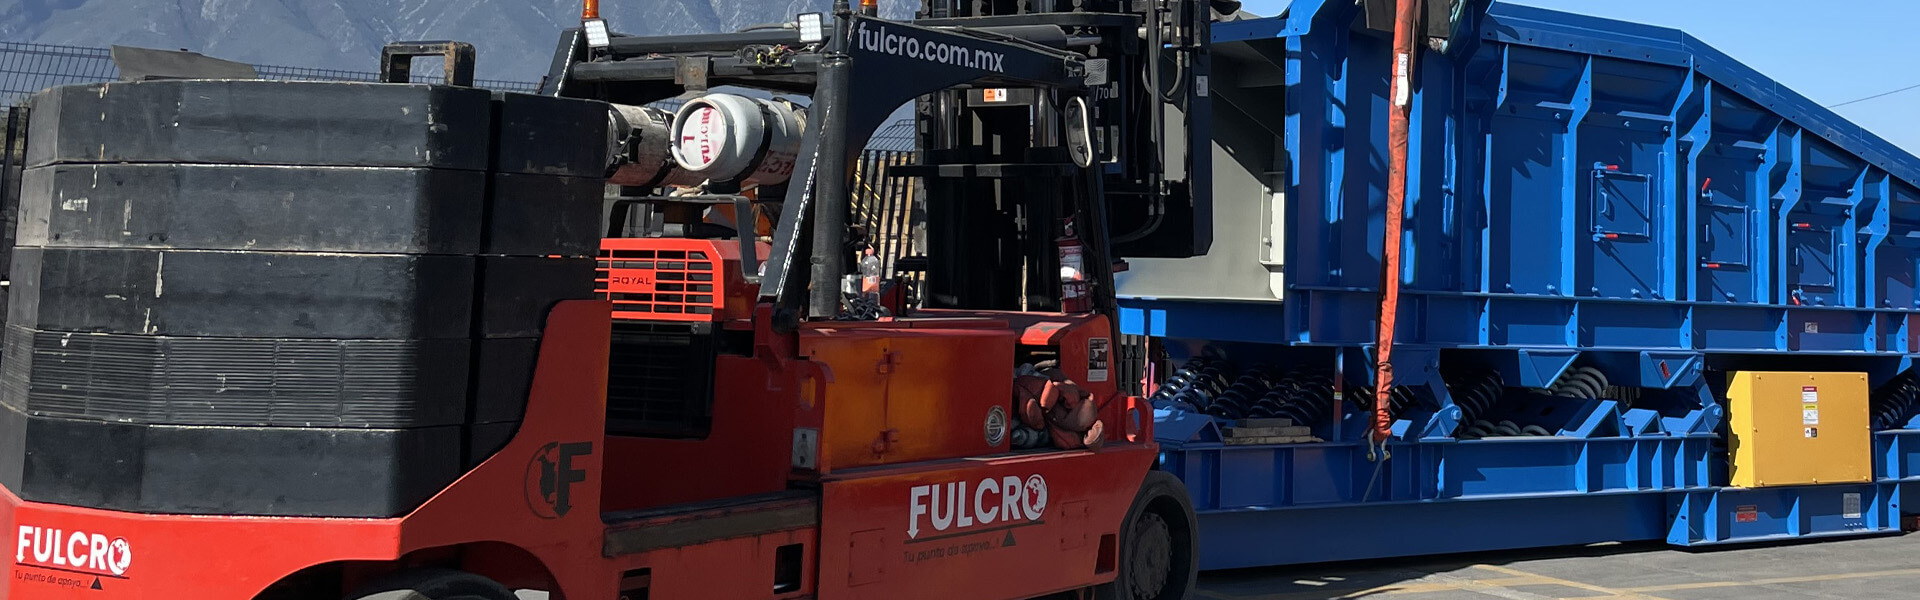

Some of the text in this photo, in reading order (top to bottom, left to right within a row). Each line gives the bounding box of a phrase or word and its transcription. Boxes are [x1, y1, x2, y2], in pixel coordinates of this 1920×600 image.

[858, 22, 1004, 73] fulcro.com.mx
[700, 107, 712, 164] FULCRO
[612, 277, 652, 285] ROYAL
[907, 474, 1048, 539] FULCRO
[16, 525, 131, 575] FULCRO
[24, 572, 46, 582] punto
[47, 575, 57, 583] de
